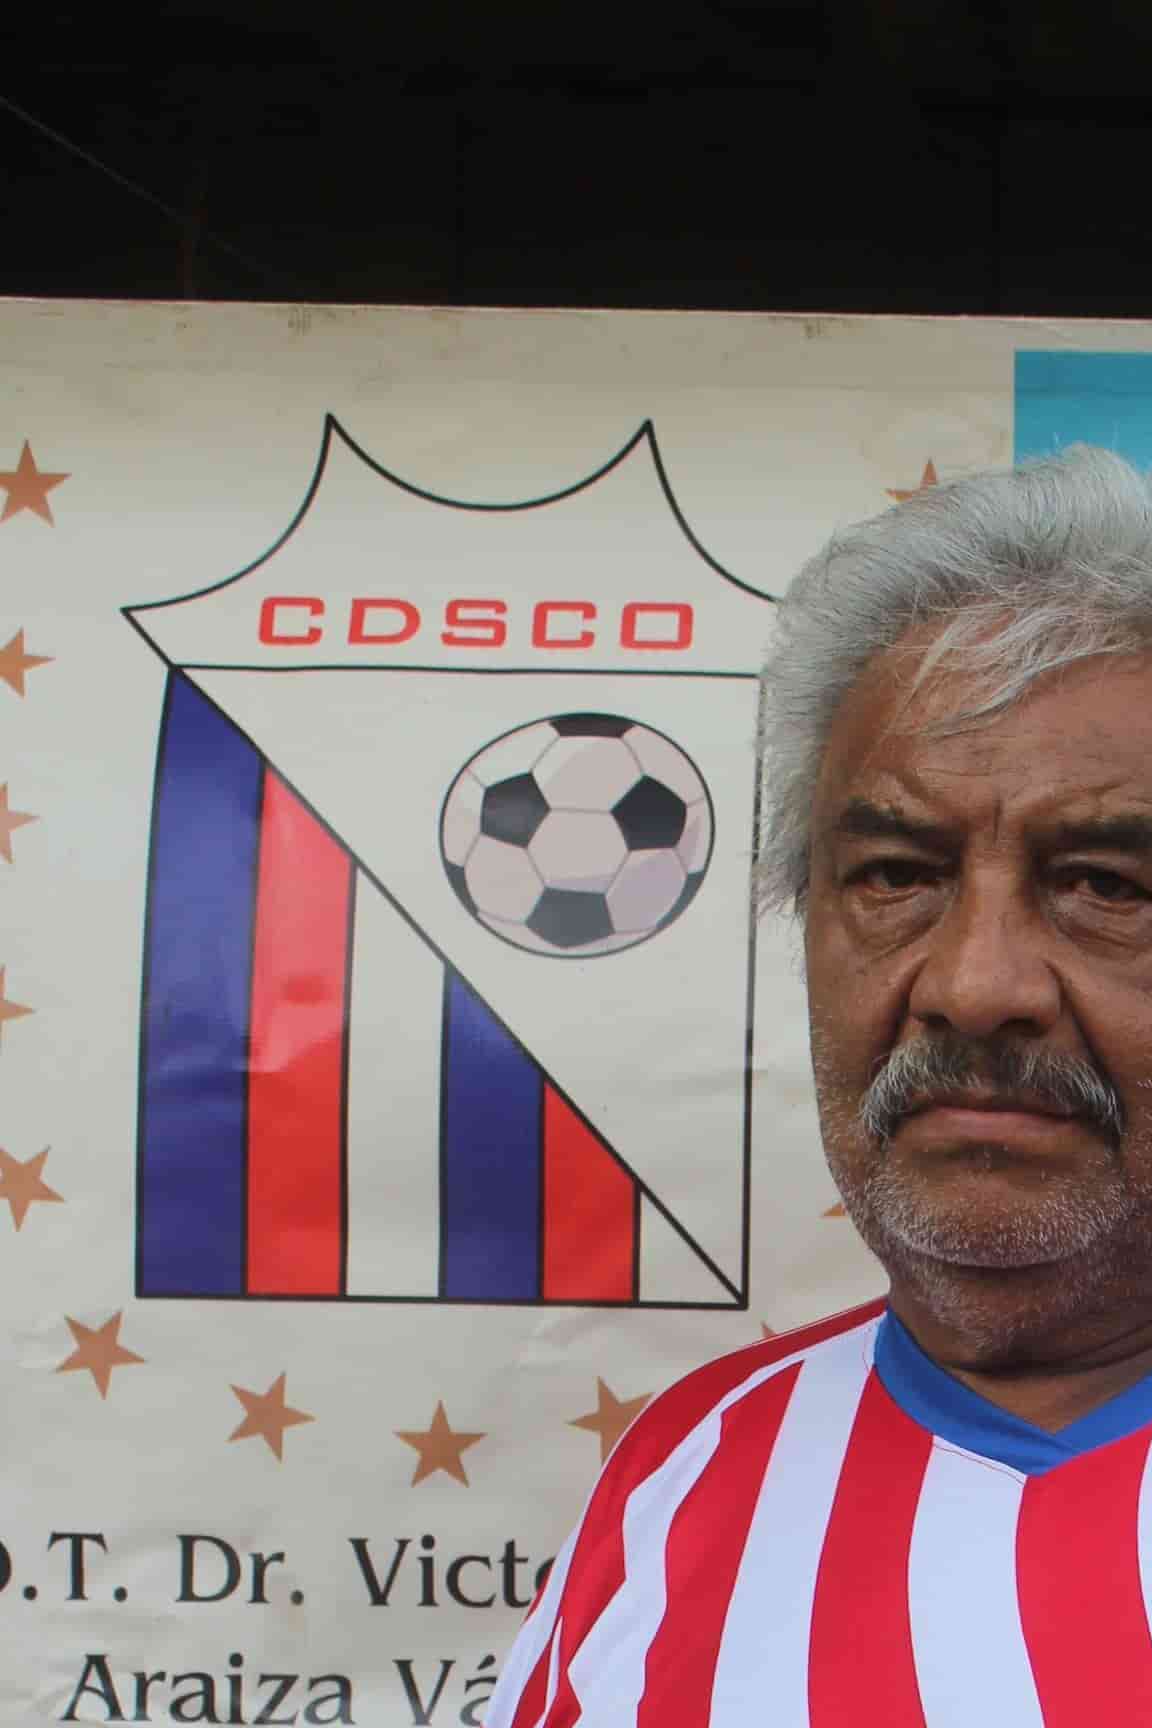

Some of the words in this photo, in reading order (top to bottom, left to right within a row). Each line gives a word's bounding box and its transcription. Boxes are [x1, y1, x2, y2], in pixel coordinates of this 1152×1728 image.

[258, 597, 694, 649] CDSCO
[0, 1531, 128, 1603] .T.
[175, 1534, 304, 1605] Dr.
[58, 1653, 355, 1726] Araiza
